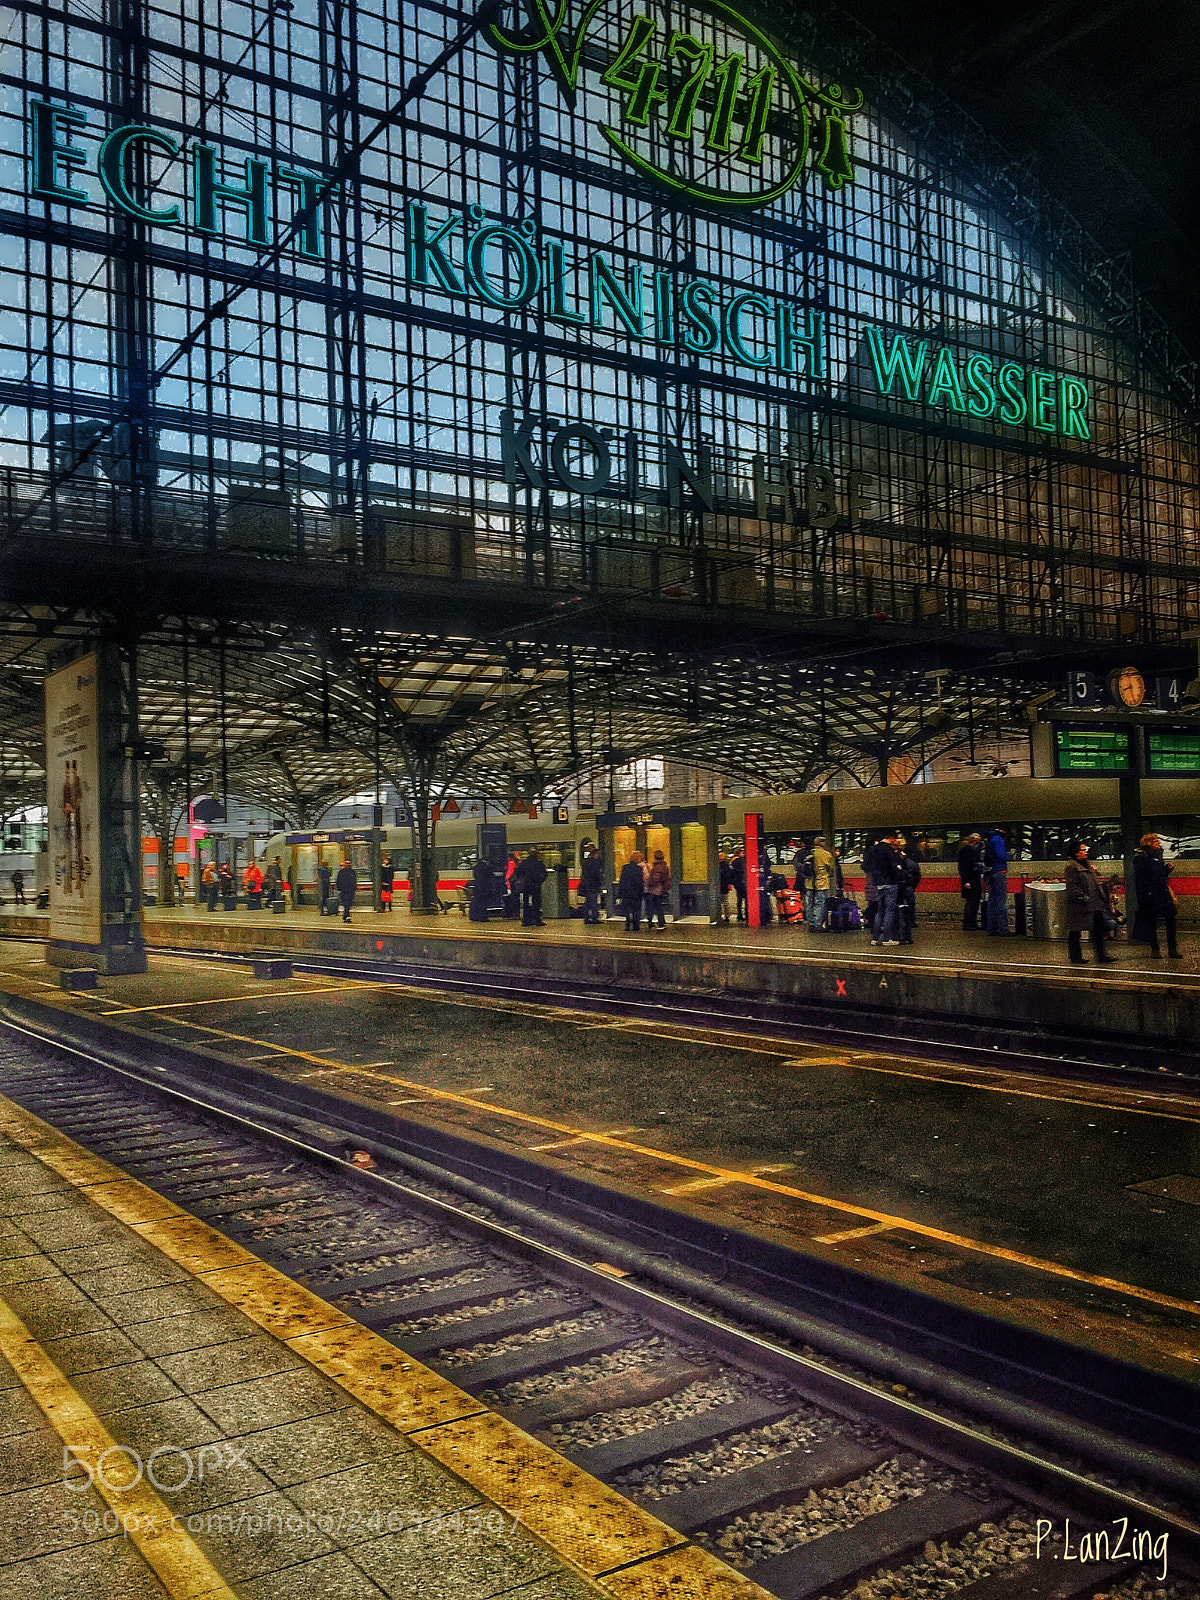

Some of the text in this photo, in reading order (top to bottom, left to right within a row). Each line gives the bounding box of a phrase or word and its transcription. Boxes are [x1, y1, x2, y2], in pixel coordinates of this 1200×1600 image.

[604, 15, 775, 165] 4711
[31, 99, 1092, 440] ECHT KÖLNISCH WASSER
[1075, 672, 1088, 699] 5
[1168, 679, 1179, 703] 4
[557, 807, 568, 821] B
